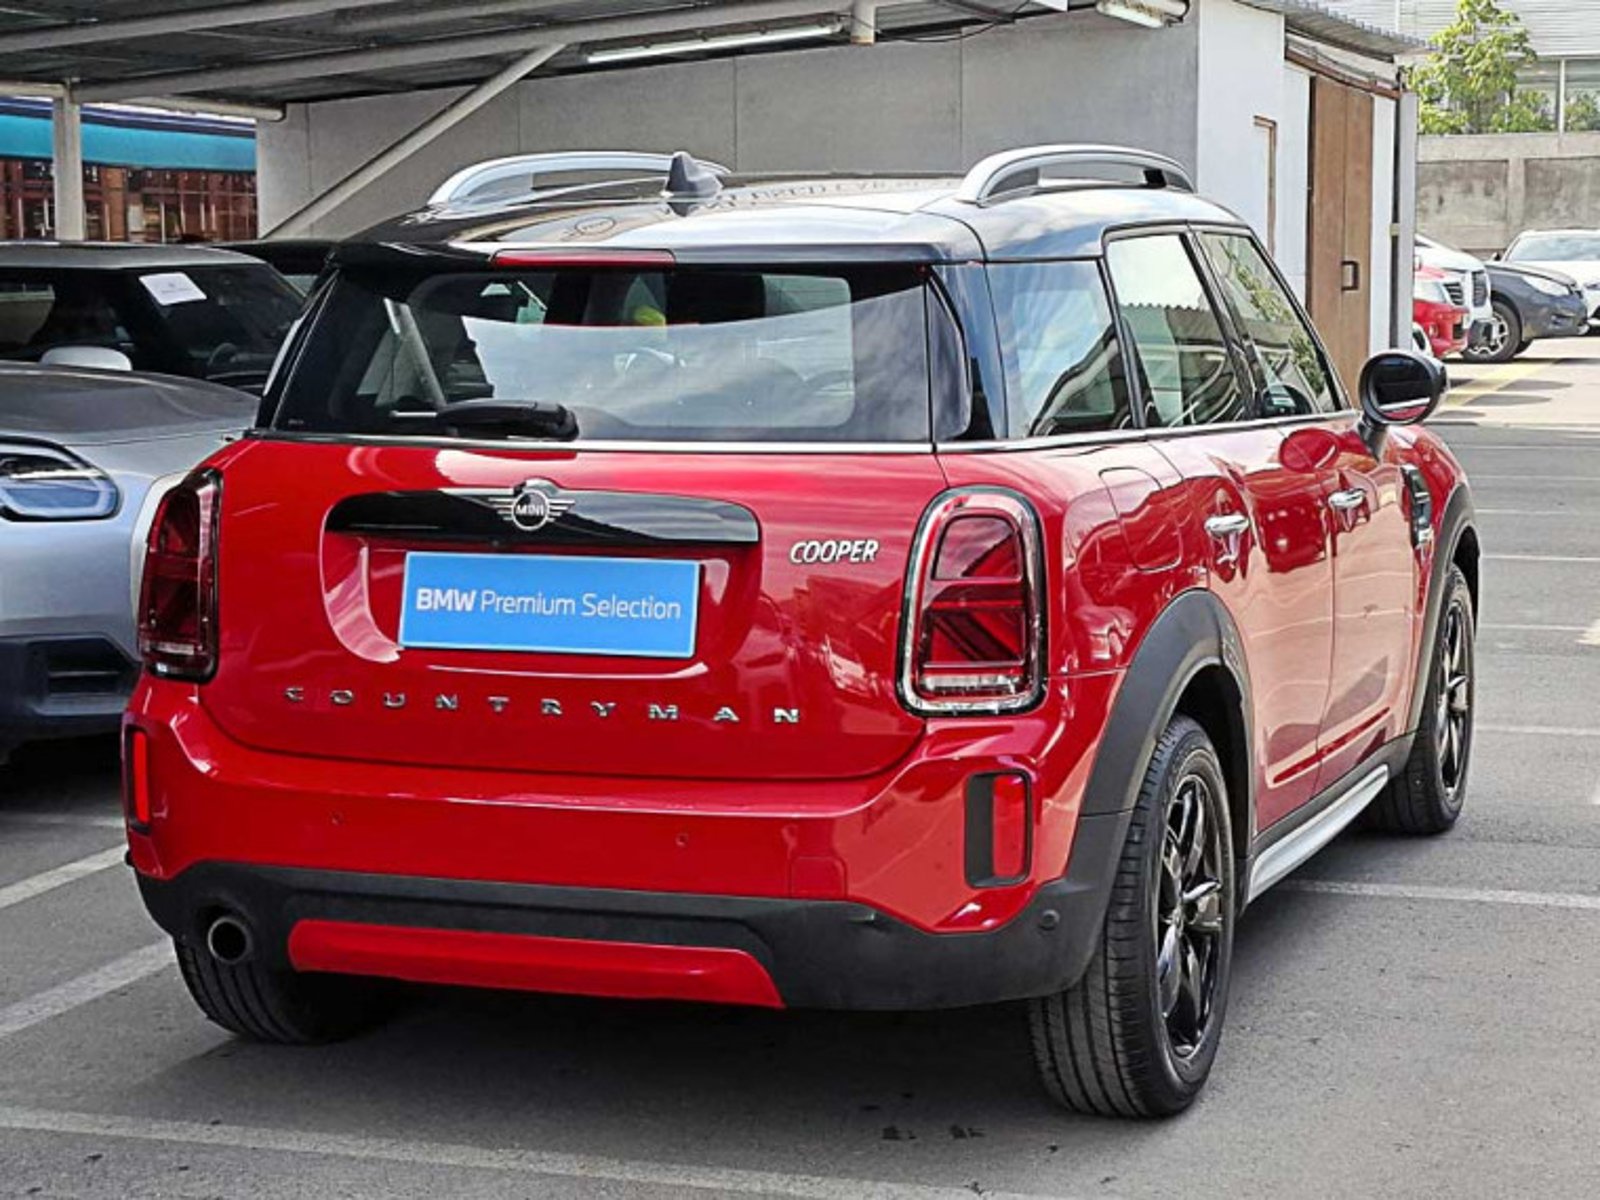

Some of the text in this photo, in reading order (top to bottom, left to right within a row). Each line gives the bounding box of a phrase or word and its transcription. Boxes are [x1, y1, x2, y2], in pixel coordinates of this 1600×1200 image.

[515, 504, 545, 517] MINI
[789, 539, 880, 564] COOPER
[416, 588, 681, 620] BMW Premium Selection
[285, 687, 799, 723] COUNTRYMAN
